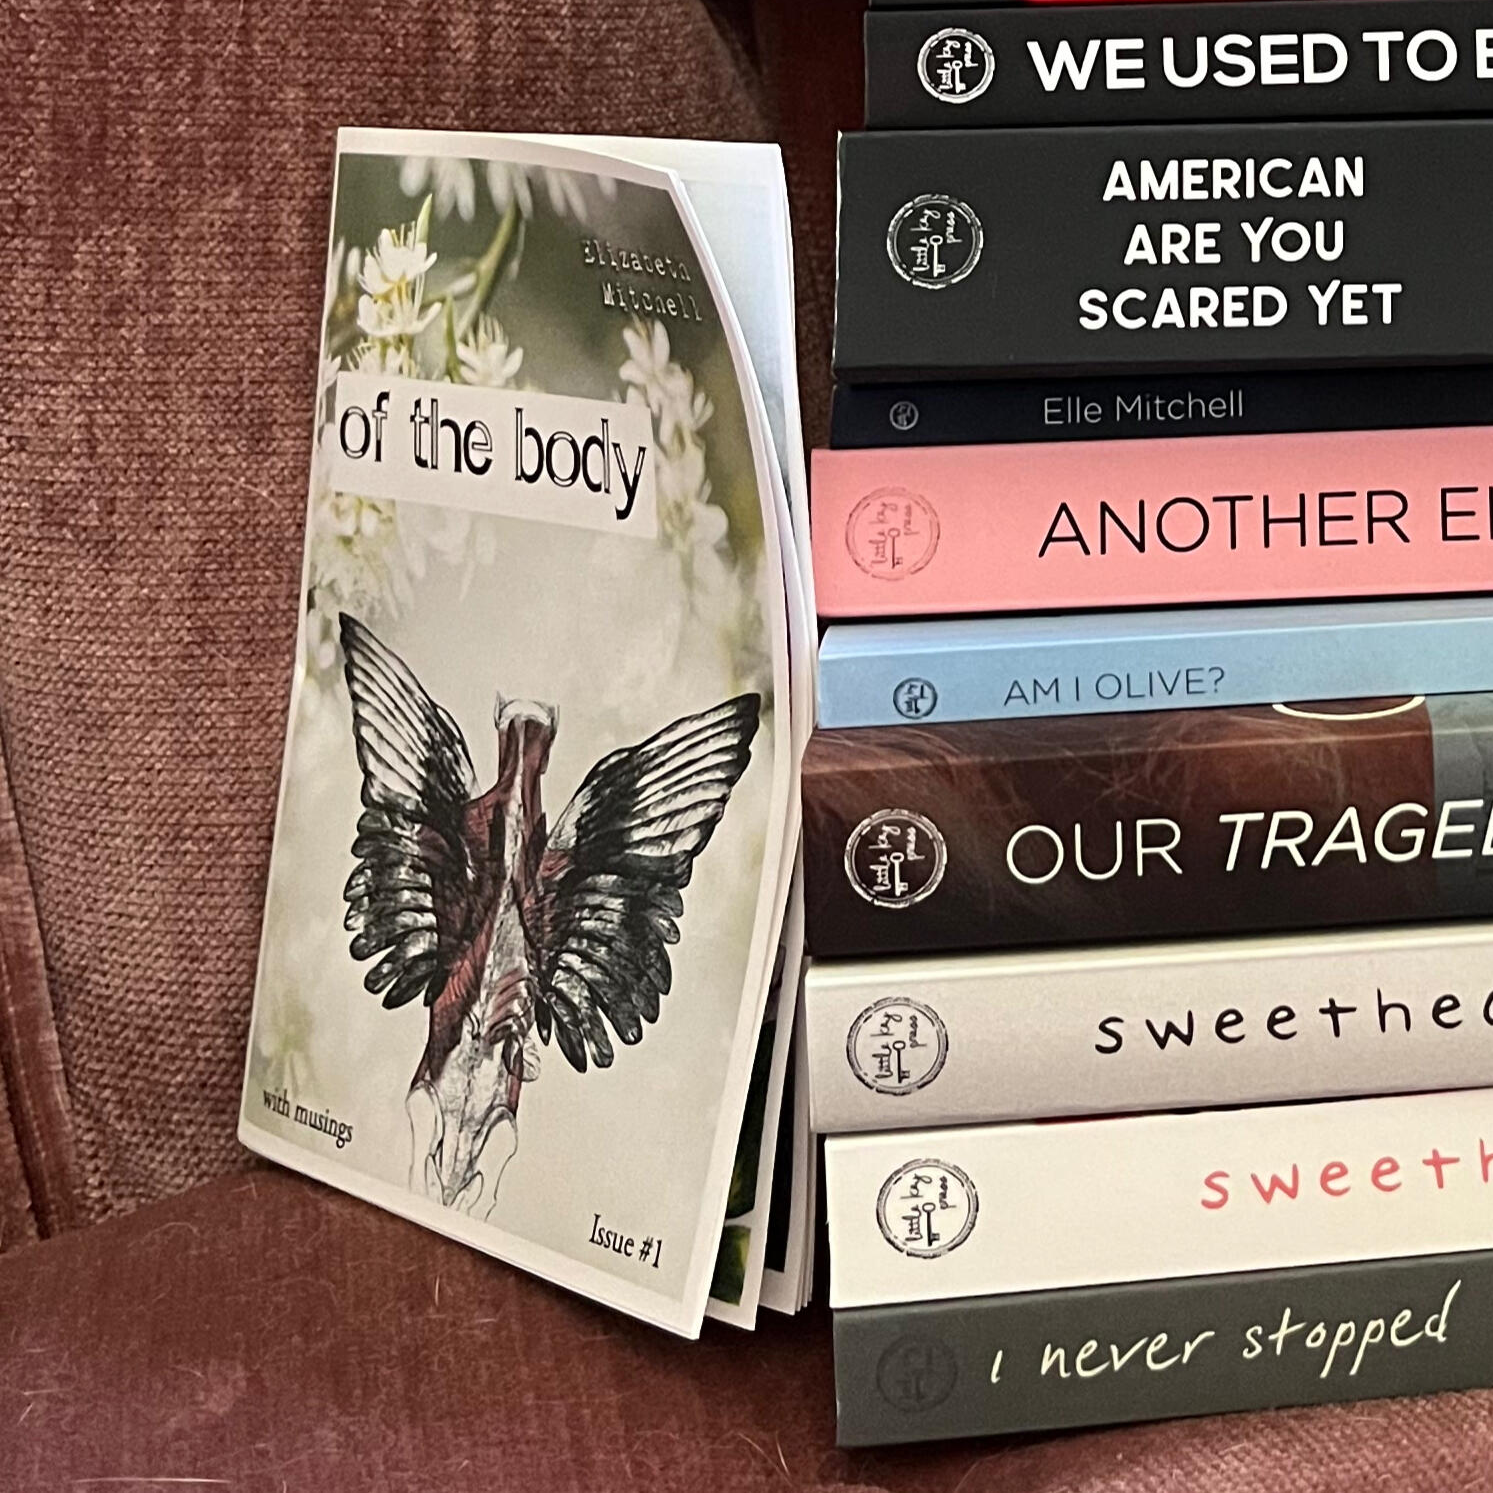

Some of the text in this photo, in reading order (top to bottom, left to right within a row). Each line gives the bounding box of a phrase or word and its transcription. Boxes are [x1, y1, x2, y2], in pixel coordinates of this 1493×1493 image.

[935, 40, 959, 58] key
[1026, 39, 1145, 91] WE
[1163, 32, 1348, 89] USED
[1362, 29, 1458, 83] TO
[1102, 156, 1365, 202] AMERICAN
[913, 210, 940, 232] key
[1123, 219, 1344, 265] ARE YOU
[1078, 282, 1402, 331] SCARED YET
[1043, 390, 1245, 426] Elle Mitchell
[339, 391, 646, 520] of the body
[869, 502, 896, 524] key
[1038, 488, 1412, 559] ANOTHER
[1004, 666, 1226, 706] AM I OLIVE?
[870, 824, 900, 849] key
[1005, 817, 1183, 885] OUR
[870, 1013, 901, 1037] key
[262, 1085, 353, 1148] with musings
[900, 1174, 931, 1199] key
[589, 1213, 663, 1268] Issue #1
[1040, 1330, 1215, 1379] never
[1242, 1279, 1461, 1378] stopped
